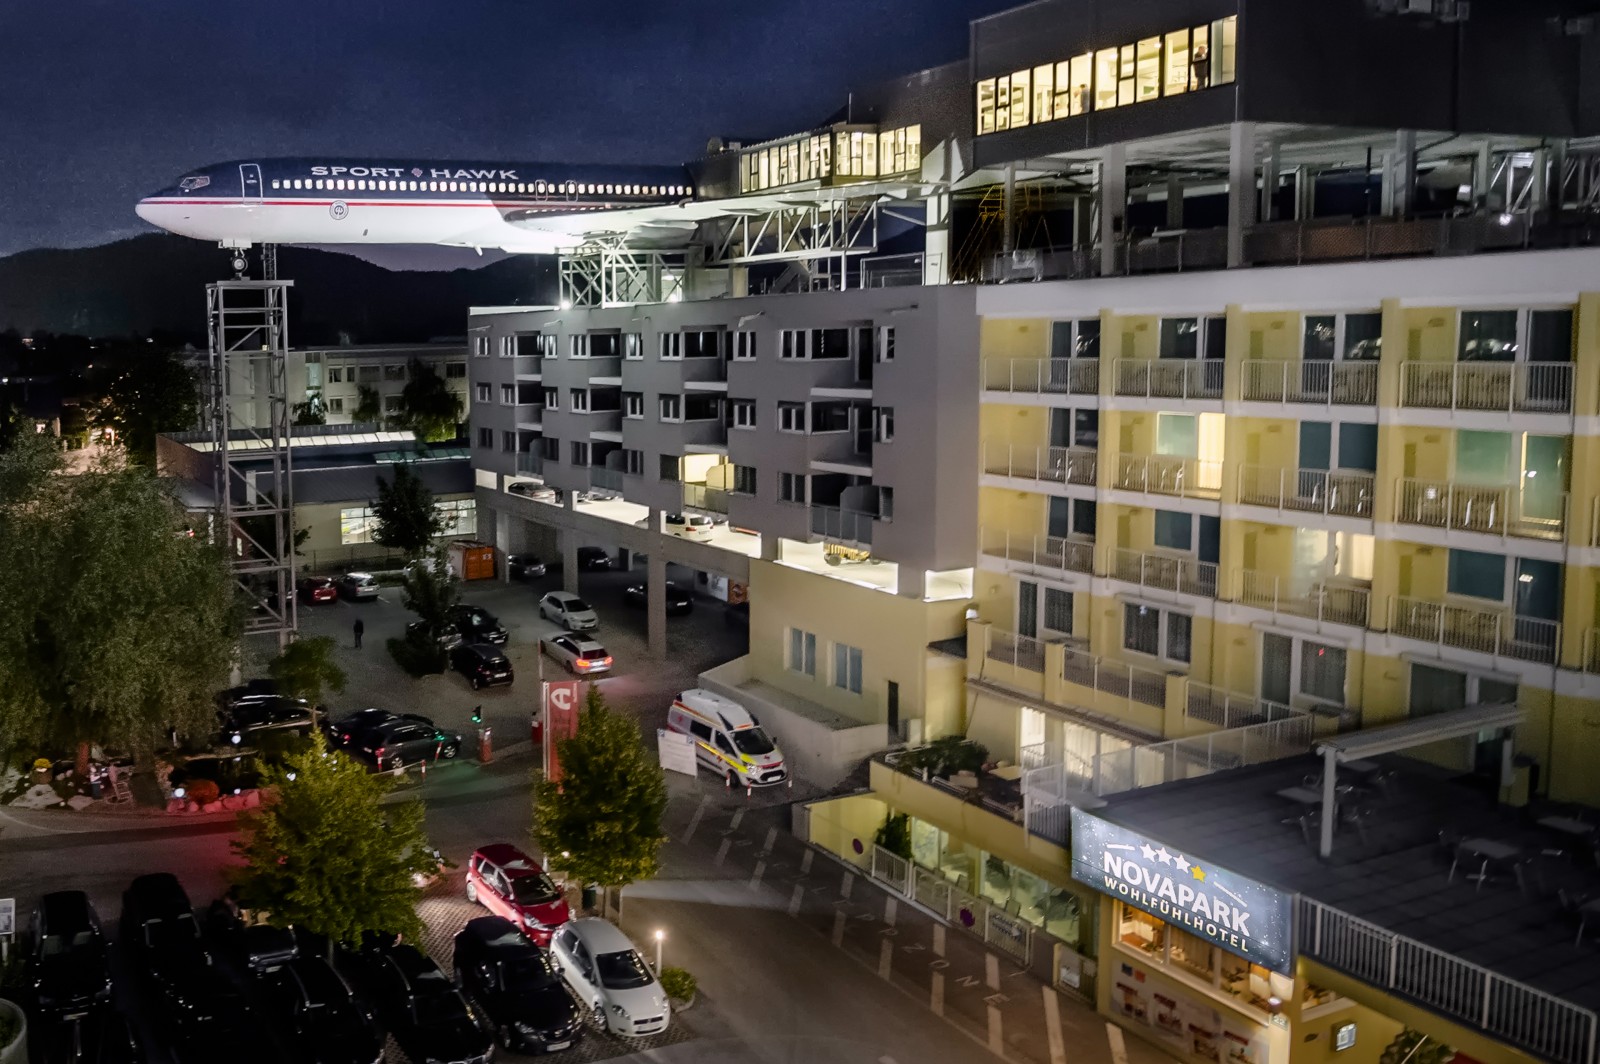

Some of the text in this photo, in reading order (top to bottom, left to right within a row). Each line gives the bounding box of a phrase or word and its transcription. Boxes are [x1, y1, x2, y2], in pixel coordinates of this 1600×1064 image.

[310, 166, 519, 180] SPORT HAWK
[1103, 851, 1251, 937] NOVAPARK
[1103, 875, 1250, 953] WOHLFÜHLHOTEL
